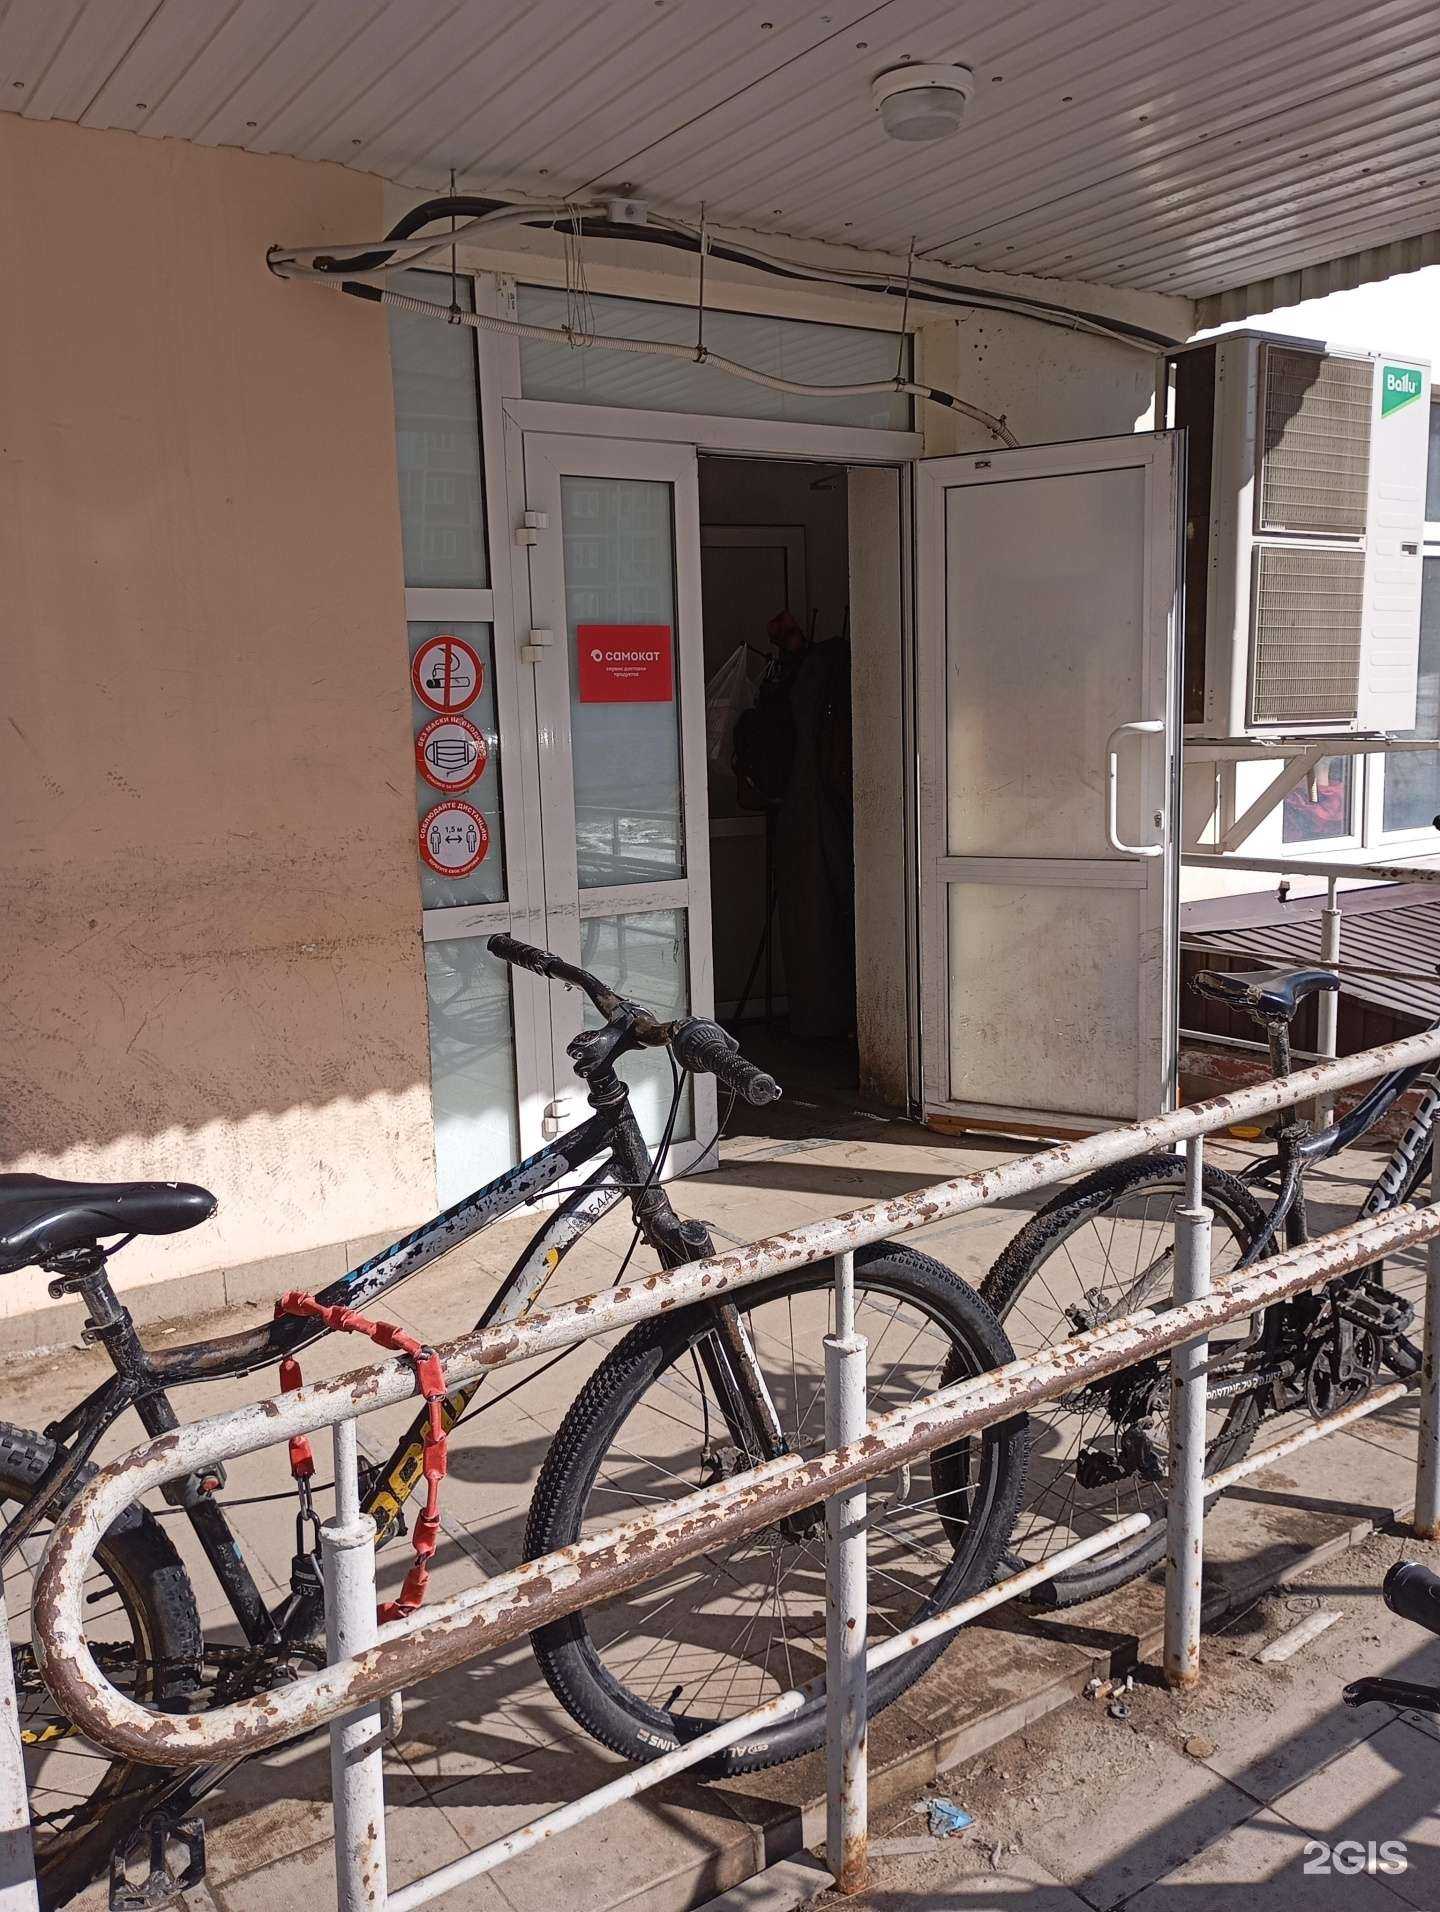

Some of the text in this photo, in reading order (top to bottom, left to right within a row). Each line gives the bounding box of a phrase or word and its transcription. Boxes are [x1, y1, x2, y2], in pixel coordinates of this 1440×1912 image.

[1387, 373, 1416, 394] Ballu
[420, 802, 488, 841] СОБЛЮДАЙТЕ ДИСТАНЦИЮ
